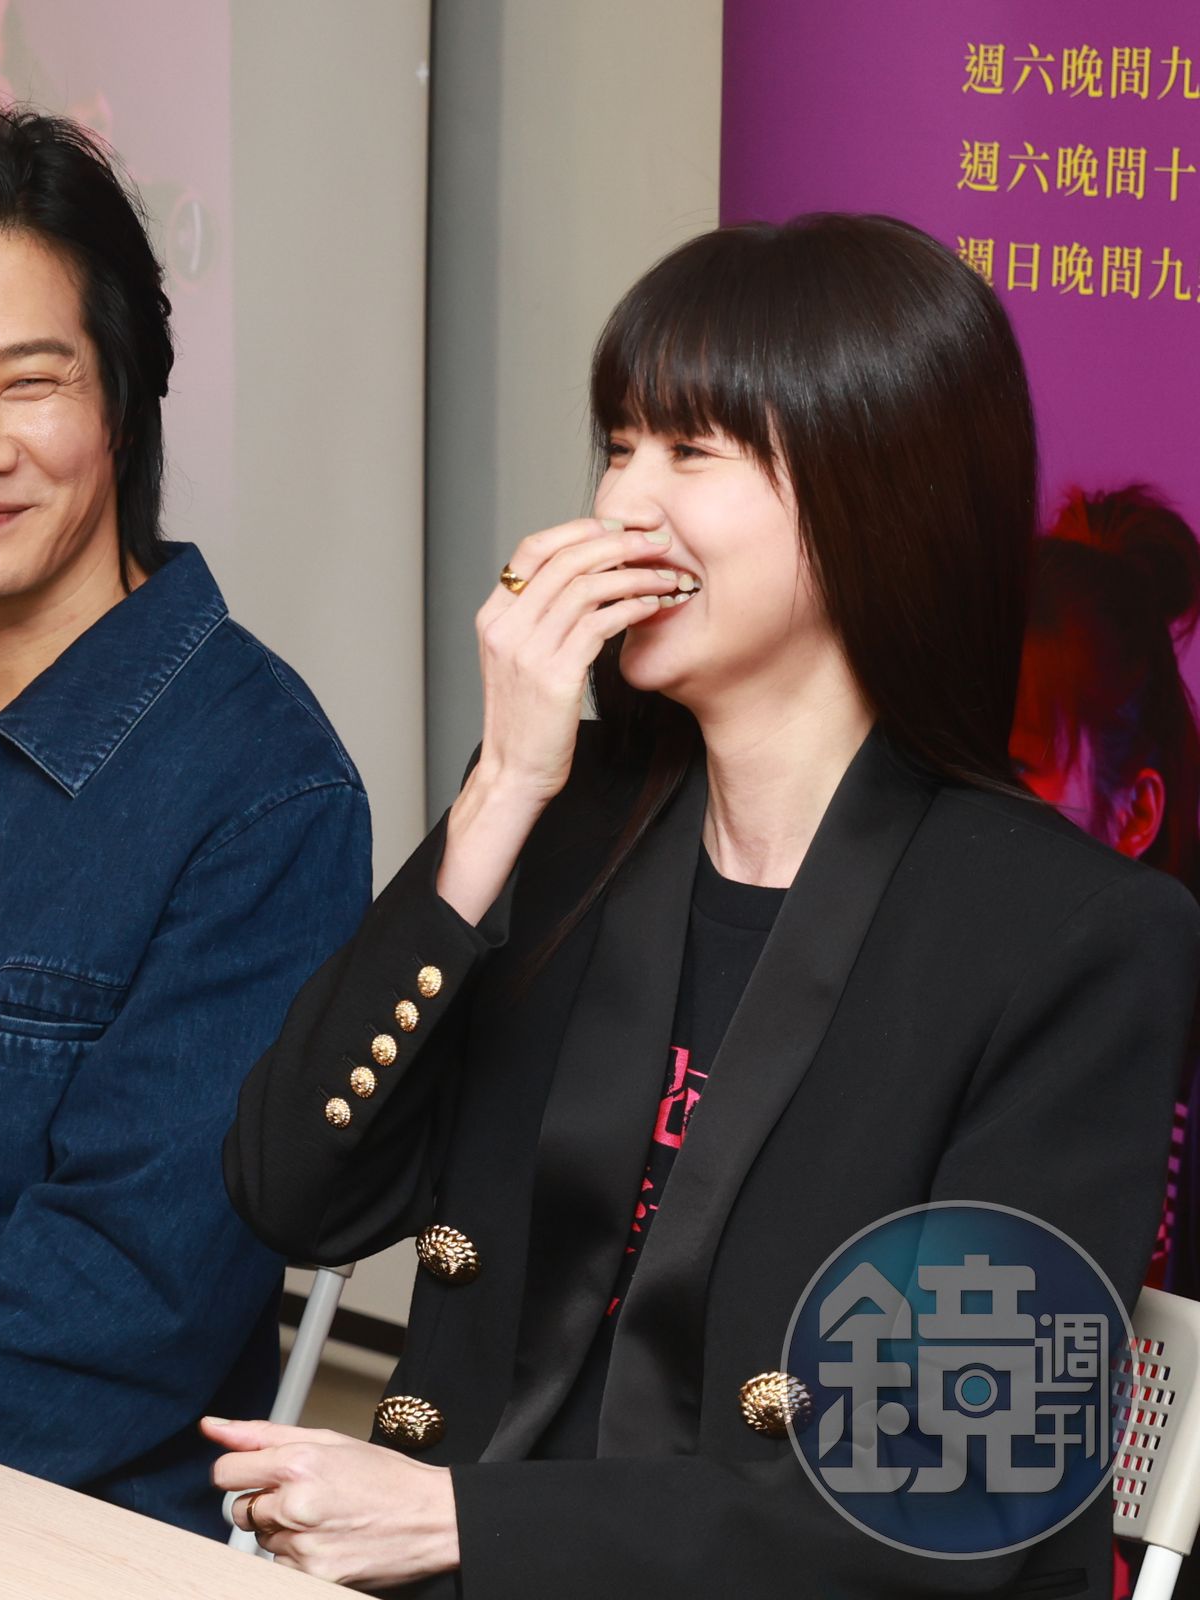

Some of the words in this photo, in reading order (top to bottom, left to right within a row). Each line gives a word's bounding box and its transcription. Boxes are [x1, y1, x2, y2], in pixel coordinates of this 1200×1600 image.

[962, 43, 1200, 100] 週六晚間九
[956, 140, 1196, 201] 週六晚間十
[956, 236, 1200, 303] 週日晚間九
